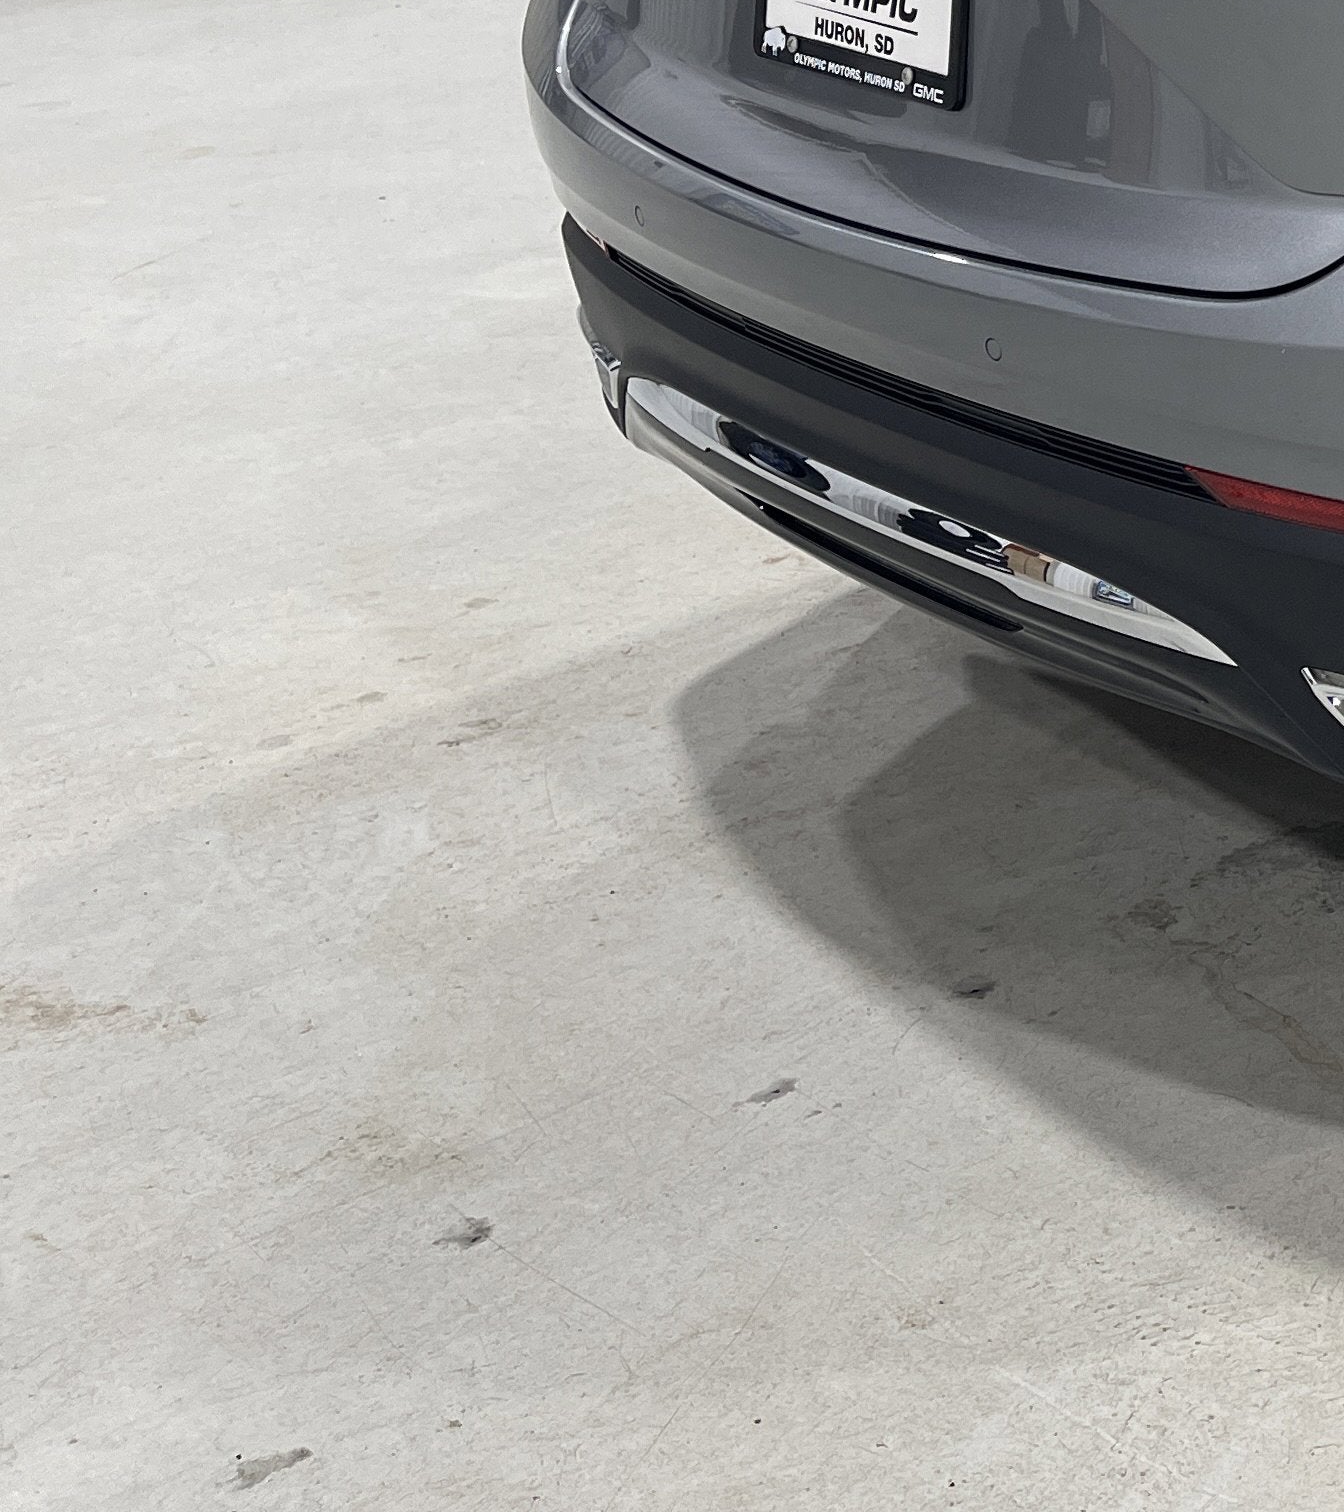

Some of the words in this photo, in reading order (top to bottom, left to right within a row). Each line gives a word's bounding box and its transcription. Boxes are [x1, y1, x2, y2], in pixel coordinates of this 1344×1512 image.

[814, 17, 869, 53] HURON,
[874, 33, 894, 56] SD
[794, 52, 826, 71] OLYMPIC
[828, 61, 863, 83] MOTORS,
[864, 71, 892, 90] HURON
[893, 79, 906, 93] SD
[913, 82, 944, 104] GMC
